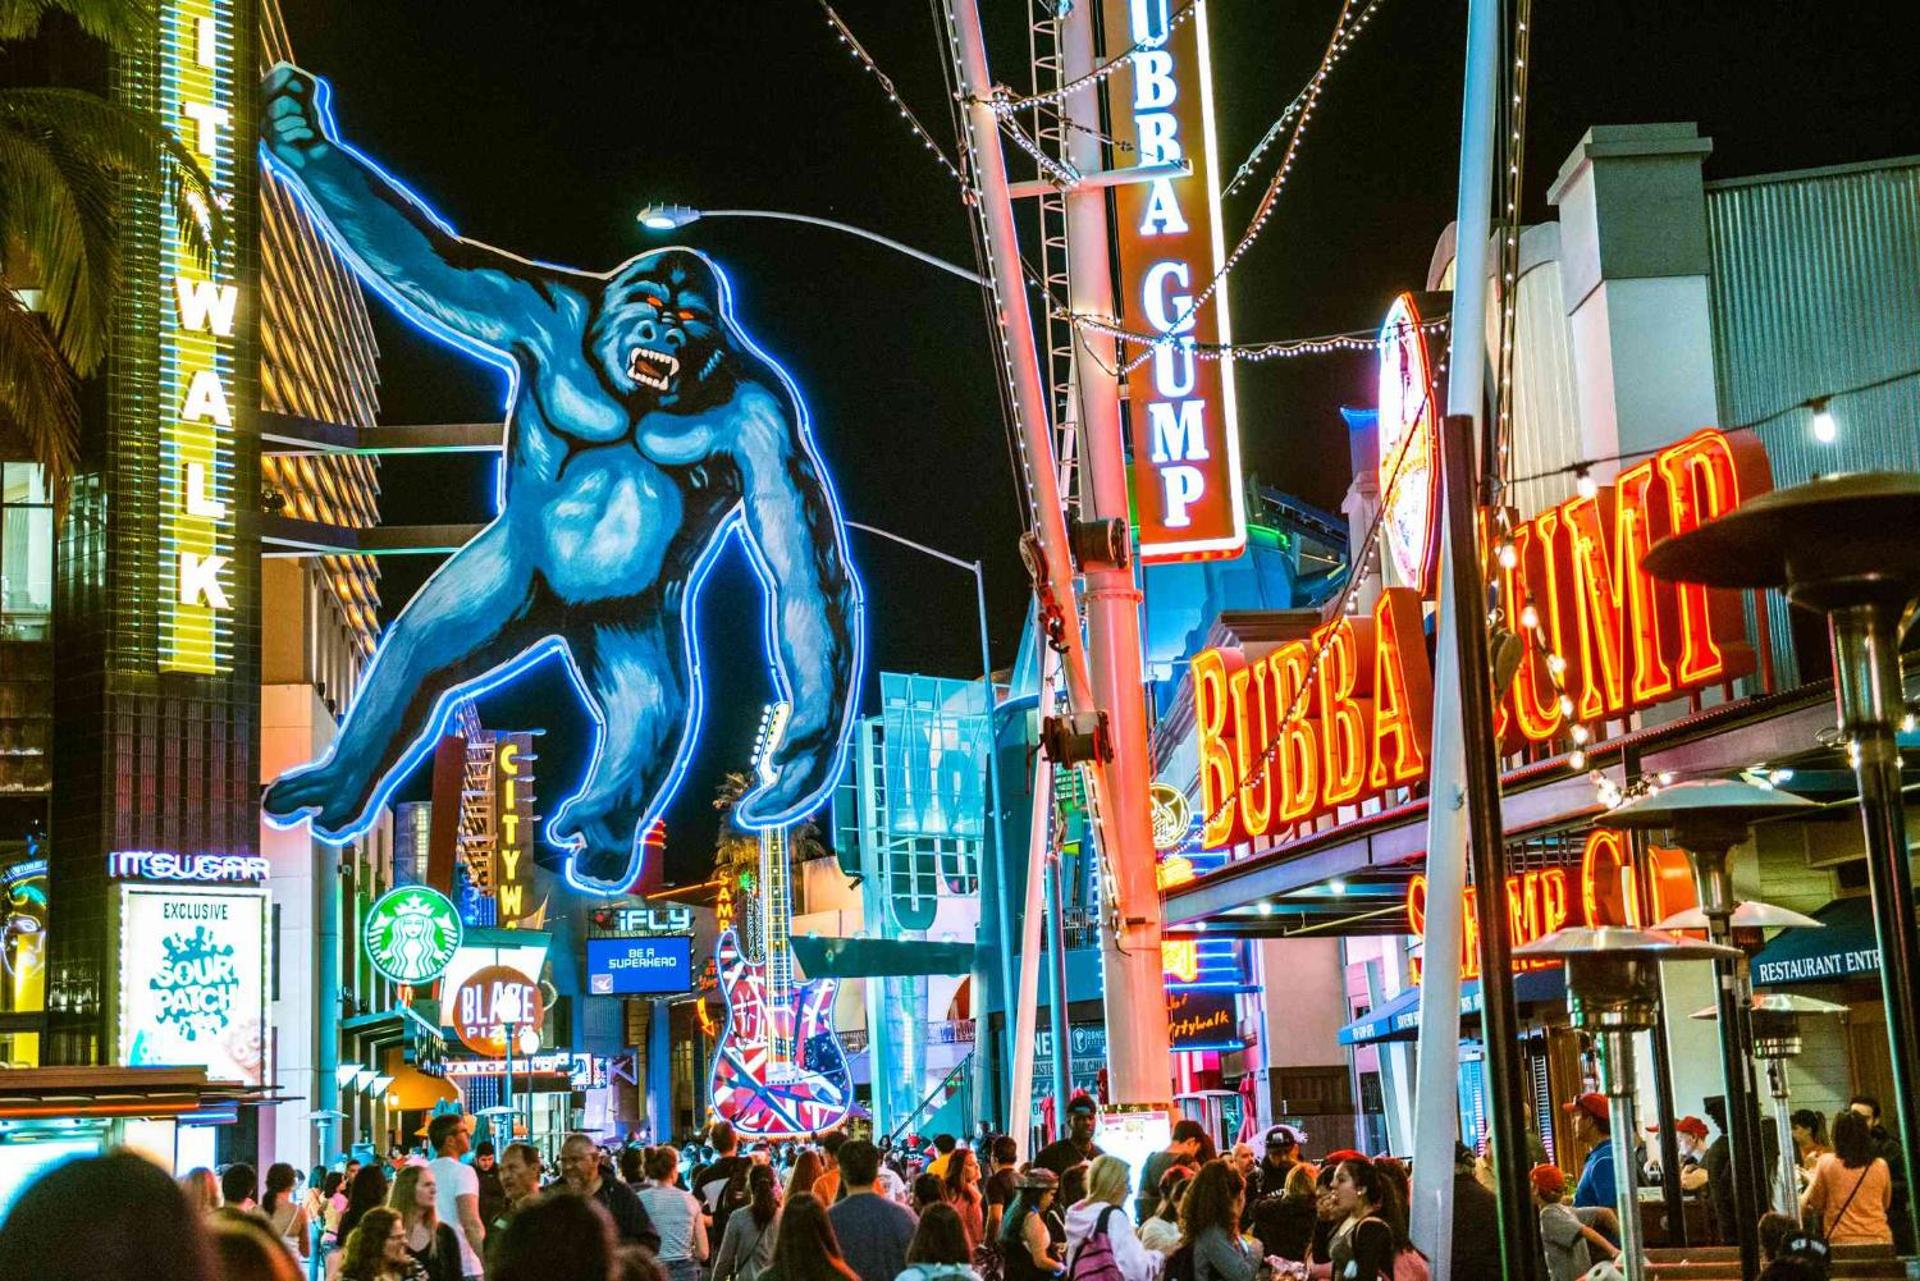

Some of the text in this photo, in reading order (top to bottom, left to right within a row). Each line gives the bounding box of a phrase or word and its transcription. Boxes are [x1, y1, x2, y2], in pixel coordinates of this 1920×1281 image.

[1143, 262, 1209, 528] GUMP
[1191, 429, 1741, 850] BUBBA UMP
[163, 902, 229, 920] EXCLUSIVE
[619, 908, 691, 932] iFLY
[608, 957, 677, 969] SUPERHERO
[628, 947, 655, 958] BE A
[155, 956, 234, 988] SOUR
[1759, 954, 1842, 983] RESTAURANT
[156, 984, 240, 1014] PATCH
[466, 1025, 535, 1040] PIZA
